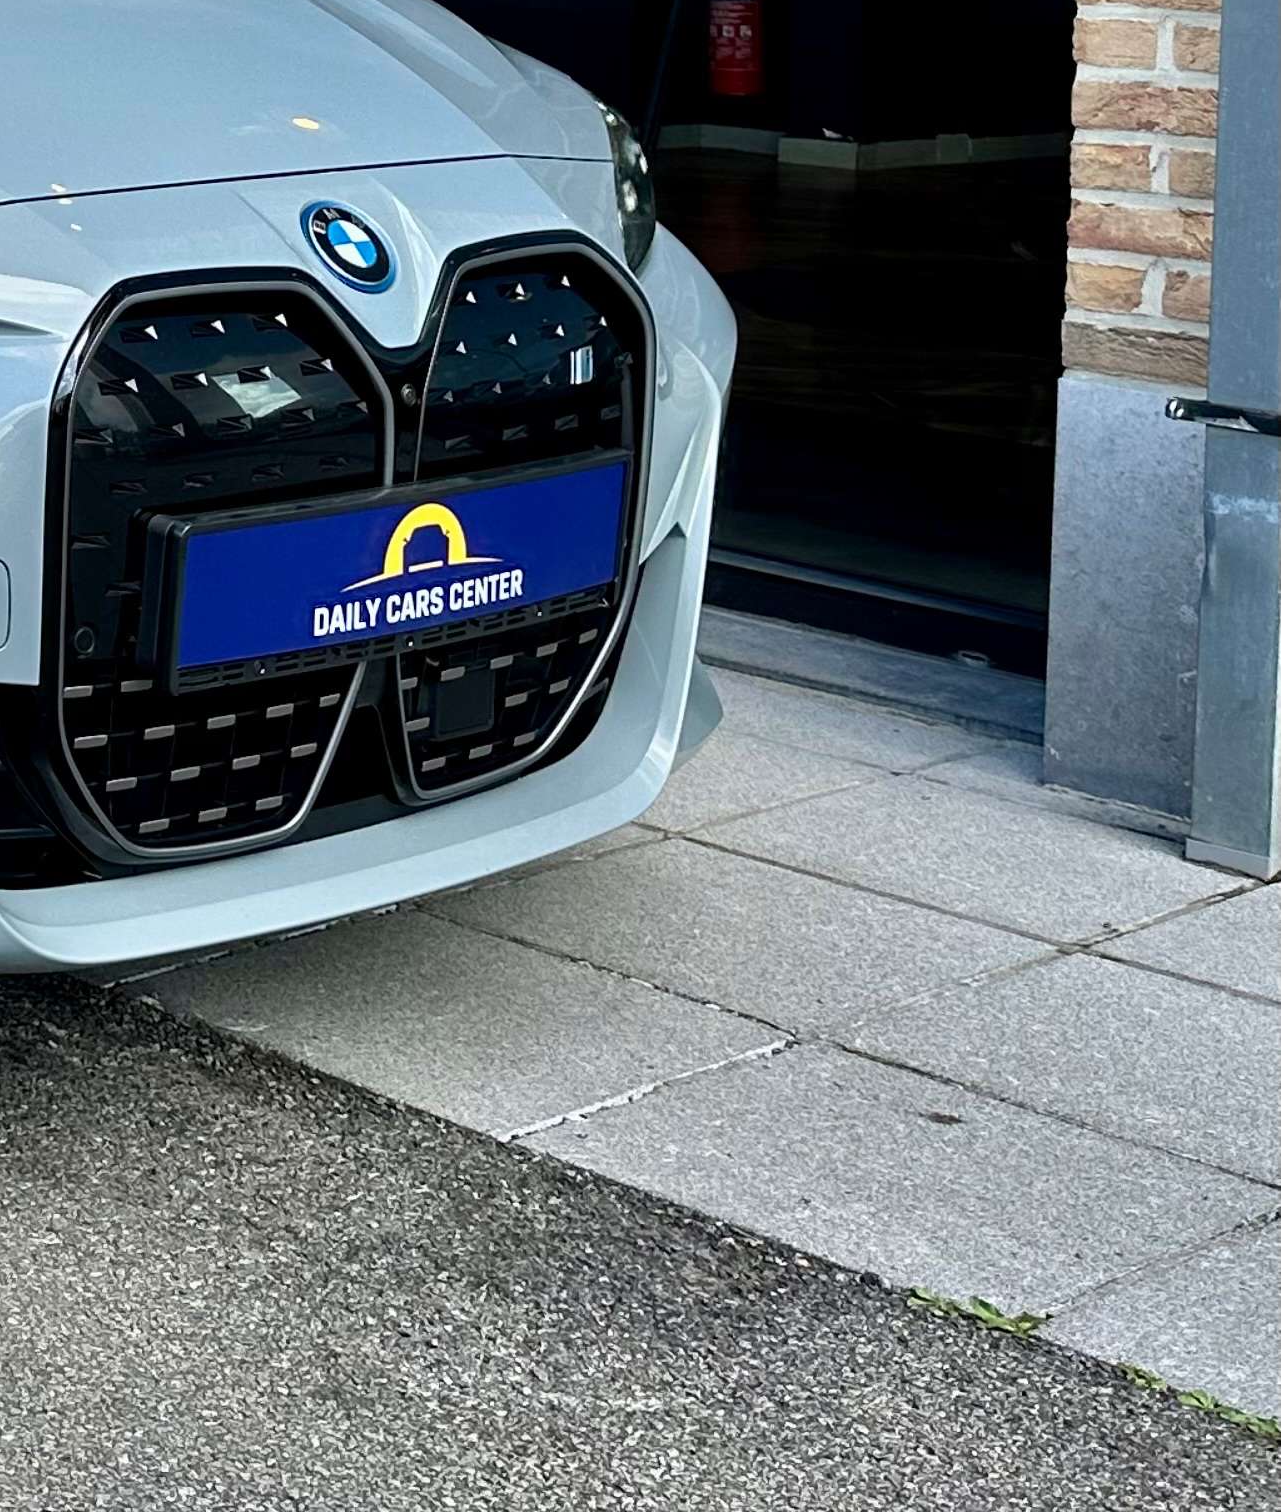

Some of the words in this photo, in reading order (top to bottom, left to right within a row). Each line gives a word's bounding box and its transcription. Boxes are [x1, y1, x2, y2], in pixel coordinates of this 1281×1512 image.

[313, 597, 381, 637] DAILY
[386, 586, 444, 624] CARS
[449, 569, 523, 611] CENTER
